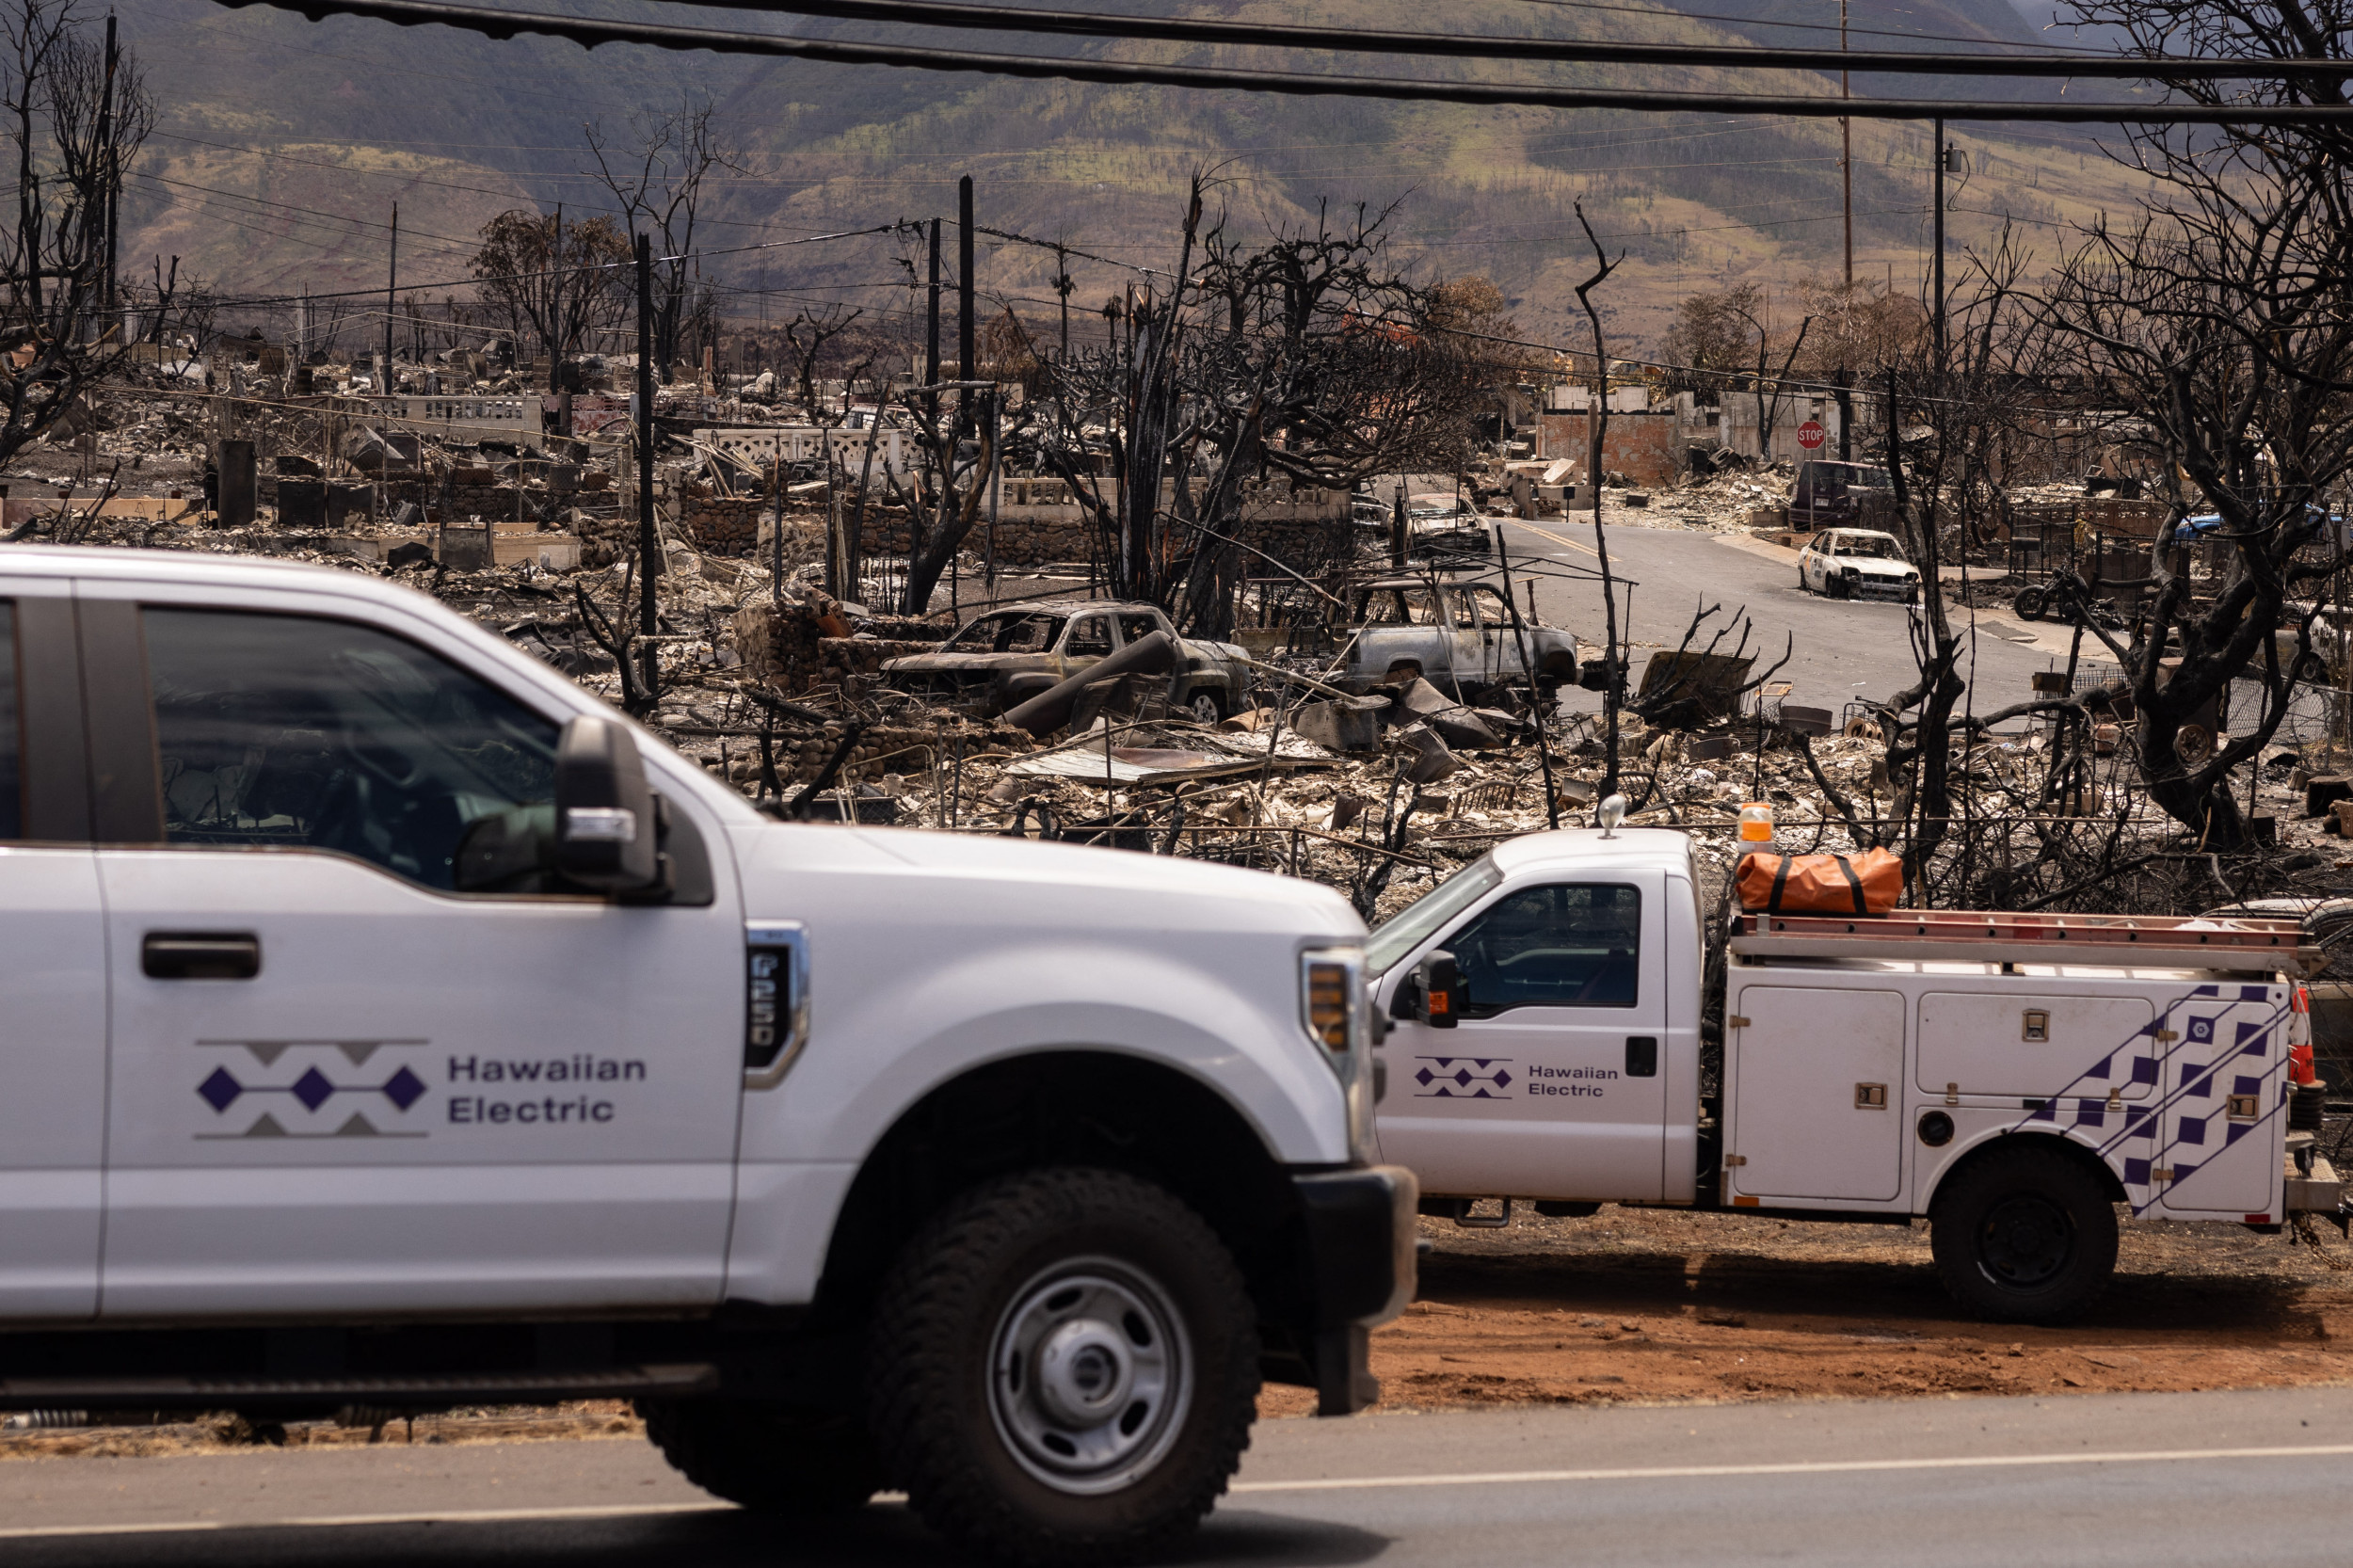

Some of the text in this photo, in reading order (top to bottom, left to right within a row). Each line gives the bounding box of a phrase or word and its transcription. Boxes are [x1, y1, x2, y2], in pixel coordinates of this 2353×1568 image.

[1799, 430, 1823, 441] STOP
[447, 1054, 647, 1082] Hawaiian
[1529, 1065, 1618, 1080] Hawaiian
[1529, 1083, 1604, 1097] Electric
[448, 1096, 615, 1123] Electric
